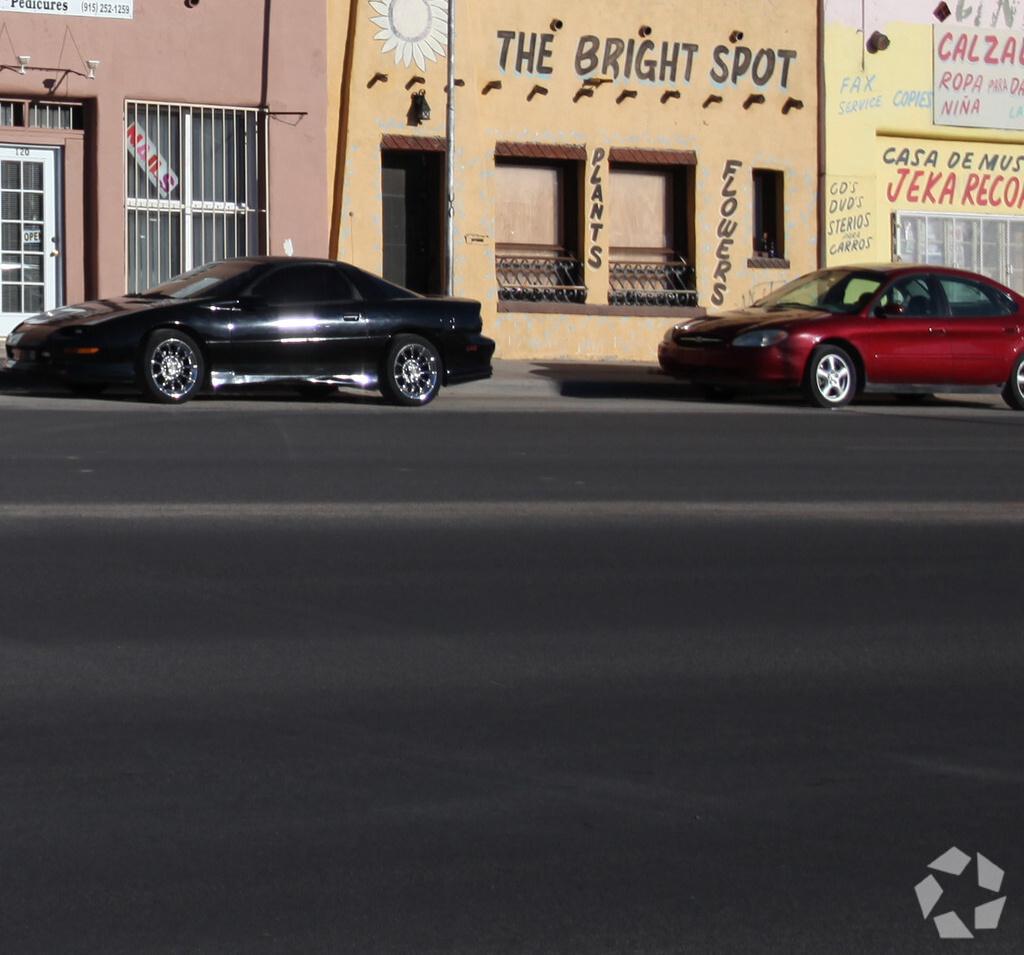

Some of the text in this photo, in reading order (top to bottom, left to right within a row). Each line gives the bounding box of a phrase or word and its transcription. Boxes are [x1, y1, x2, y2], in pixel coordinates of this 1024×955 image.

[81, 2, 98, 13] (915)
[100, 3, 130, 15] 252-1259
[497, 30, 797, 89] THE BRIGHT SPOT
[840, 75, 876, 93] FAX
[939, 71, 983, 92] ROPA
[838, 96, 882, 115] SERVICE
[893, 90, 933, 108] COPIES
[941, 95, 981, 115] NIÑA
[15, 148, 30, 156] 120
[127, 125, 175, 193] NAILS
[883, 148, 938, 167] CASA
[947, 151, 974, 169] DE
[830, 181, 858, 195] CD'S
[887, 168, 957, 205] JEKA
[587, 148, 605, 270] PLANTS
[711, 160, 742, 306] FLOWERS
[828, 212, 871, 235] STERIOS
[24, 231, 40, 242] OPE
[829, 237, 872, 255] CARROS
